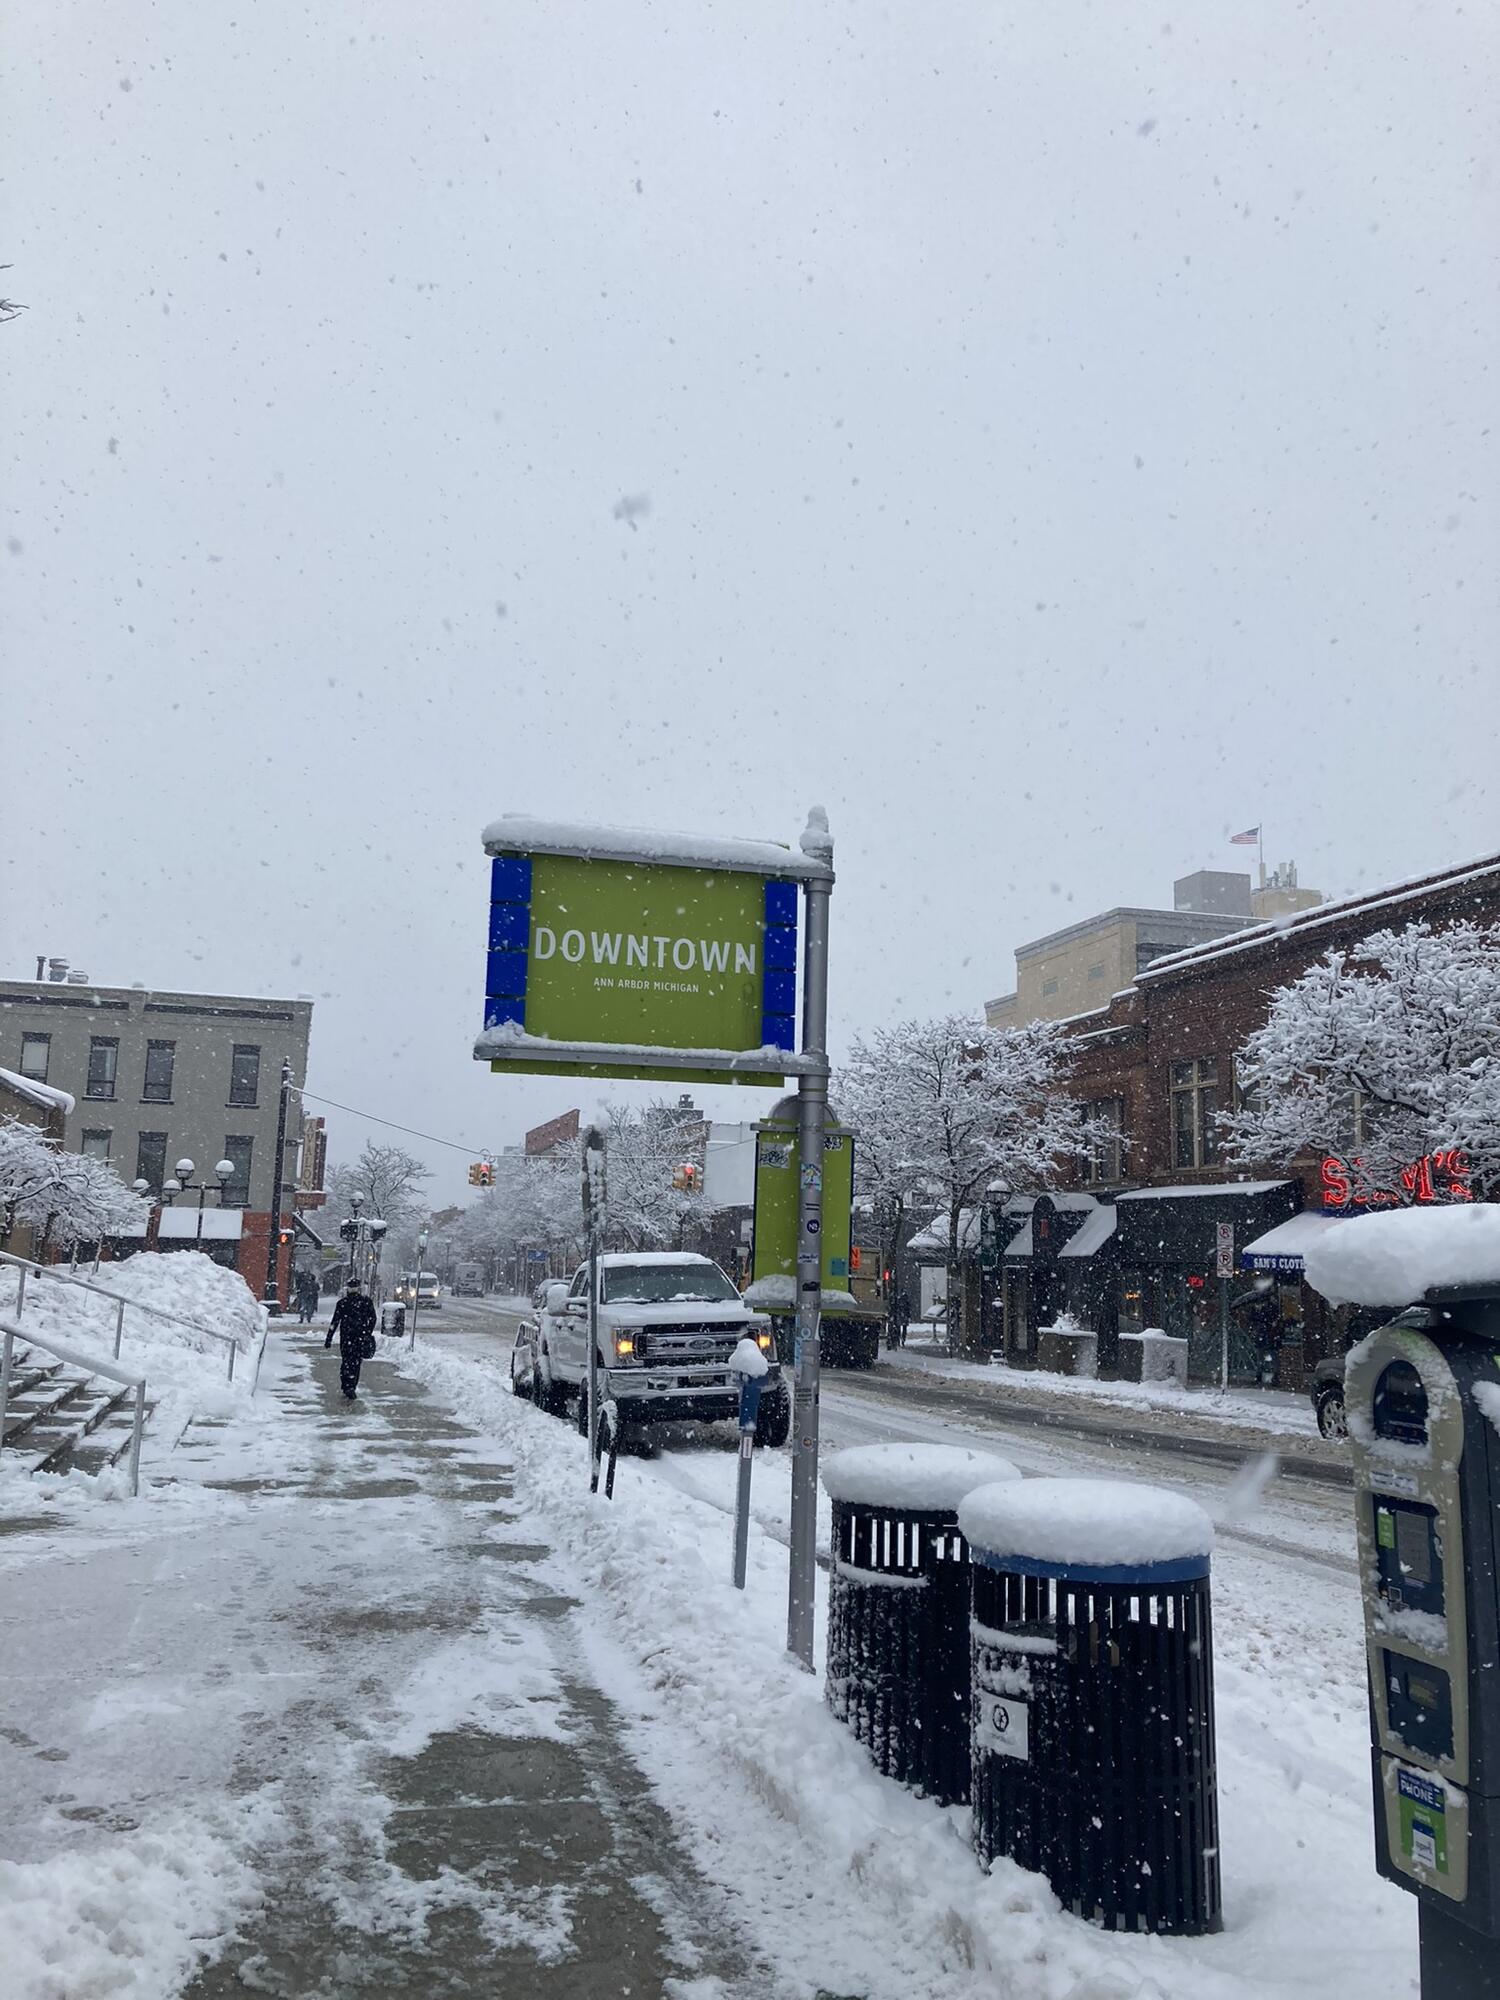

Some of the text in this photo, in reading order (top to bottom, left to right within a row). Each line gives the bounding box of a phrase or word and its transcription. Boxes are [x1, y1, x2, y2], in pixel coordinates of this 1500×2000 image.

[534, 927, 756, 975] DOWNTOWN
[593, 977, 699, 993] ANN ARBOR MICHIGAN
[1322, 1149, 1473, 1206] SM'S
[1253, 1257, 1277, 1269] SAM'S
[1400, 1779, 1434, 1805] PHONE
